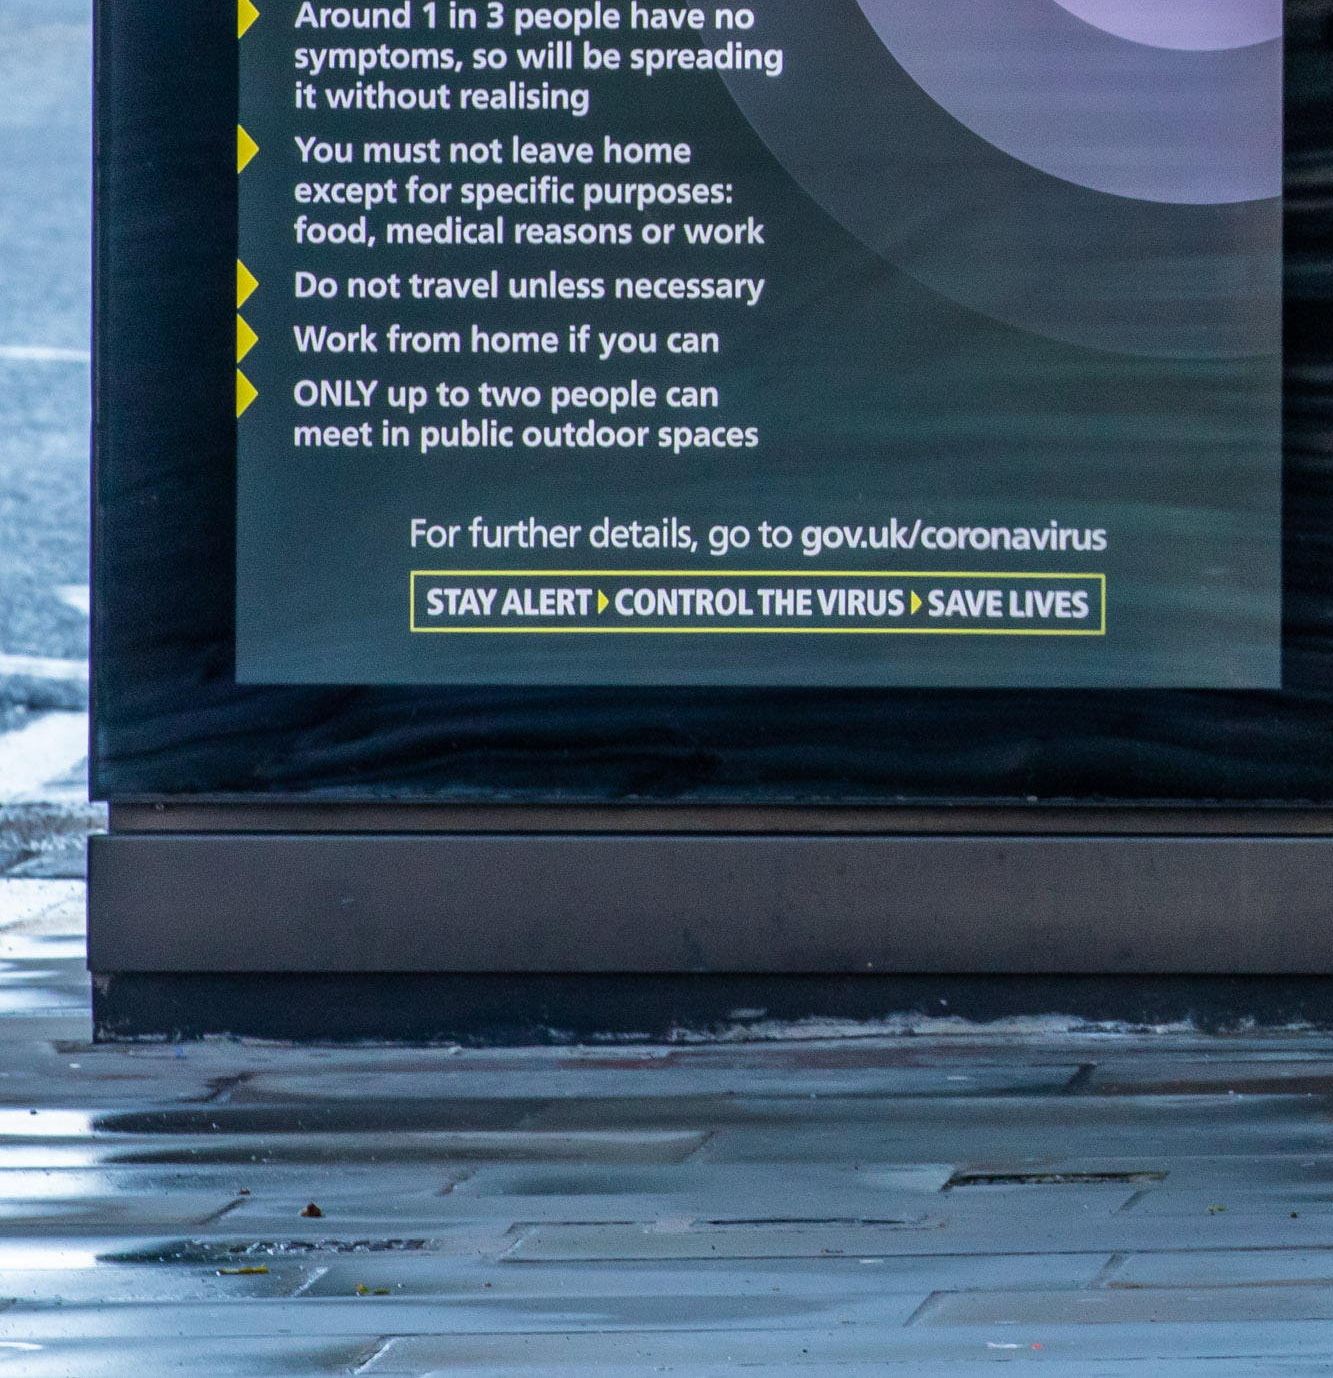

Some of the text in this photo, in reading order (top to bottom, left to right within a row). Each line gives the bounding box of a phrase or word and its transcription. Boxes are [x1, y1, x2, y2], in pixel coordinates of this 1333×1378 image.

[295, 0, 754, 35] Around 1 in 3 people have no
[295, 41, 783, 77] symptoms, so will be spreading
[296, 81, 589, 116] it without realising
[295, 135, 691, 163] You must not leave home
[295, 175, 732, 210] except for specific purposes:
[294, 215, 764, 247] food, medical reasons or work
[296, 270, 765, 306] Do not travel unless necessary
[294, 324, 719, 360] Work from home if you can
[294, 380, 718, 414] ONLY up to two people can
[295, 419, 758, 454] meet in public outdoor spaces
[411, 516, 1107, 556] For further details, go to gov.uk/coronavirus
[427, 588, 1088, 618] STAY ALERT CONTROL THE VIRUS SAVE LIVES
